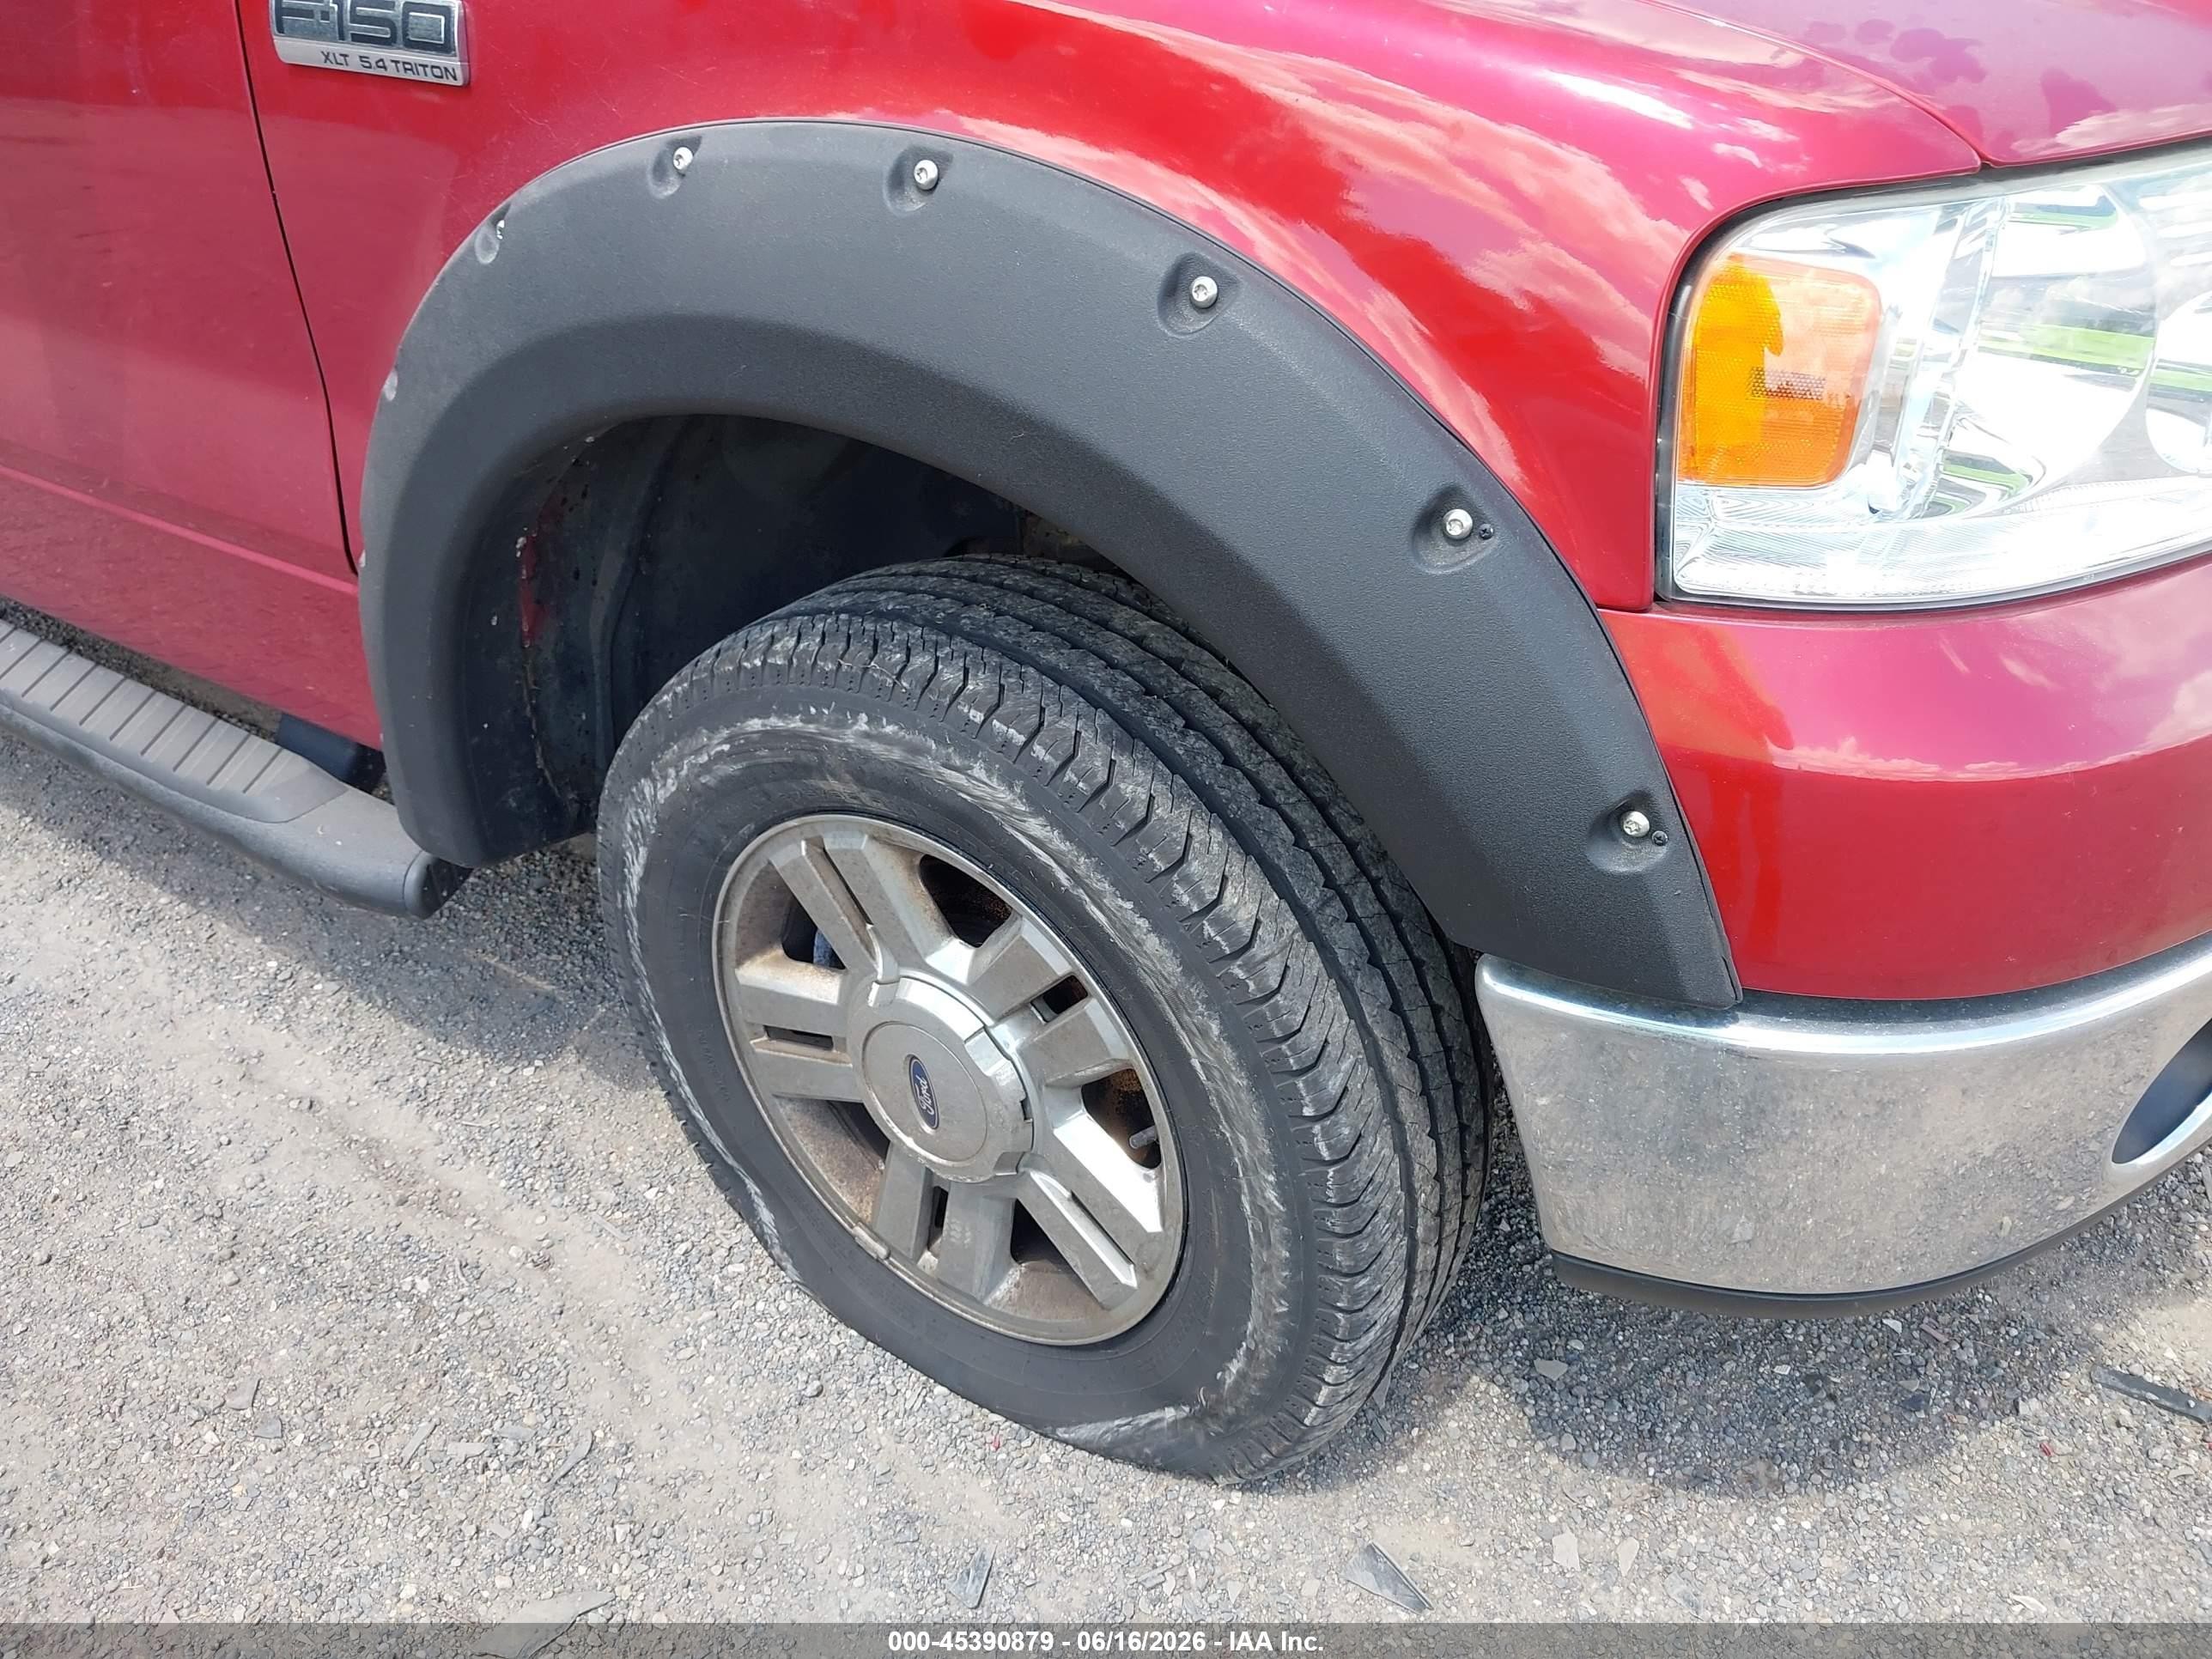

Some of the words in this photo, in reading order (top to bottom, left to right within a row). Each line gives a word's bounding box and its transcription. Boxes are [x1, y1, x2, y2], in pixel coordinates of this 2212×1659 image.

[320, 51, 349, 67] XLT
[390, 59, 458, 82] TRITON
[914, 1074, 935, 1115] Ford
